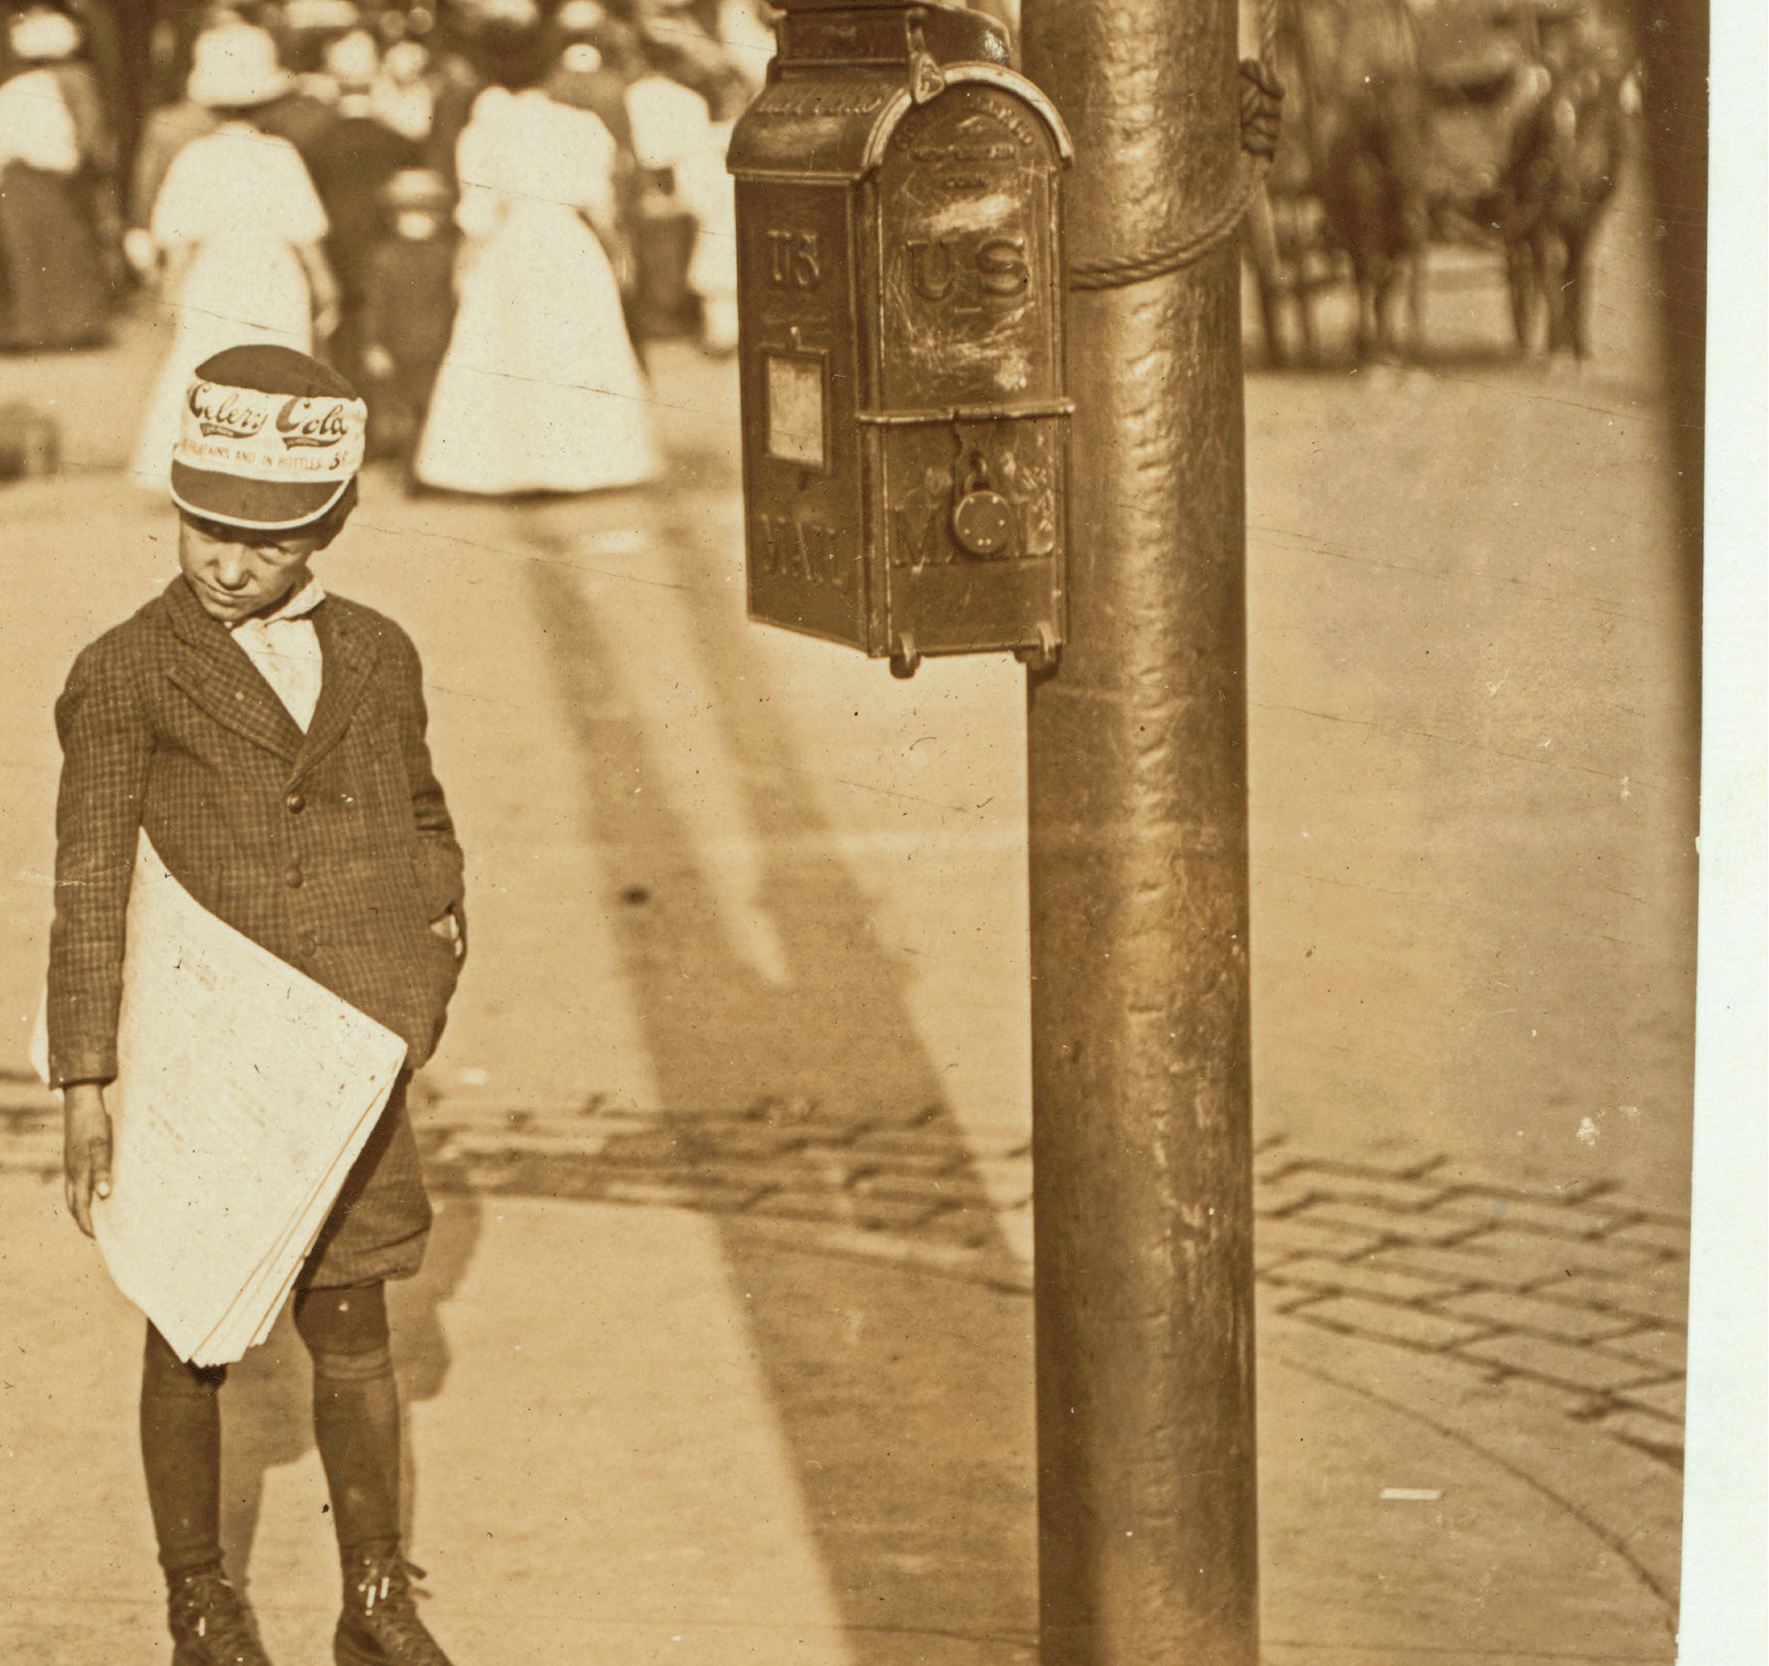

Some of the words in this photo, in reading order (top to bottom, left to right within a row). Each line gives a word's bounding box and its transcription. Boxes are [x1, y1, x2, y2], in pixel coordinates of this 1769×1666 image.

[187, 381, 269, 436] Celery
[276, 396, 348, 443] Cola
[235, 449, 256, 464] AND
[262, 454, 273, 467] IN
